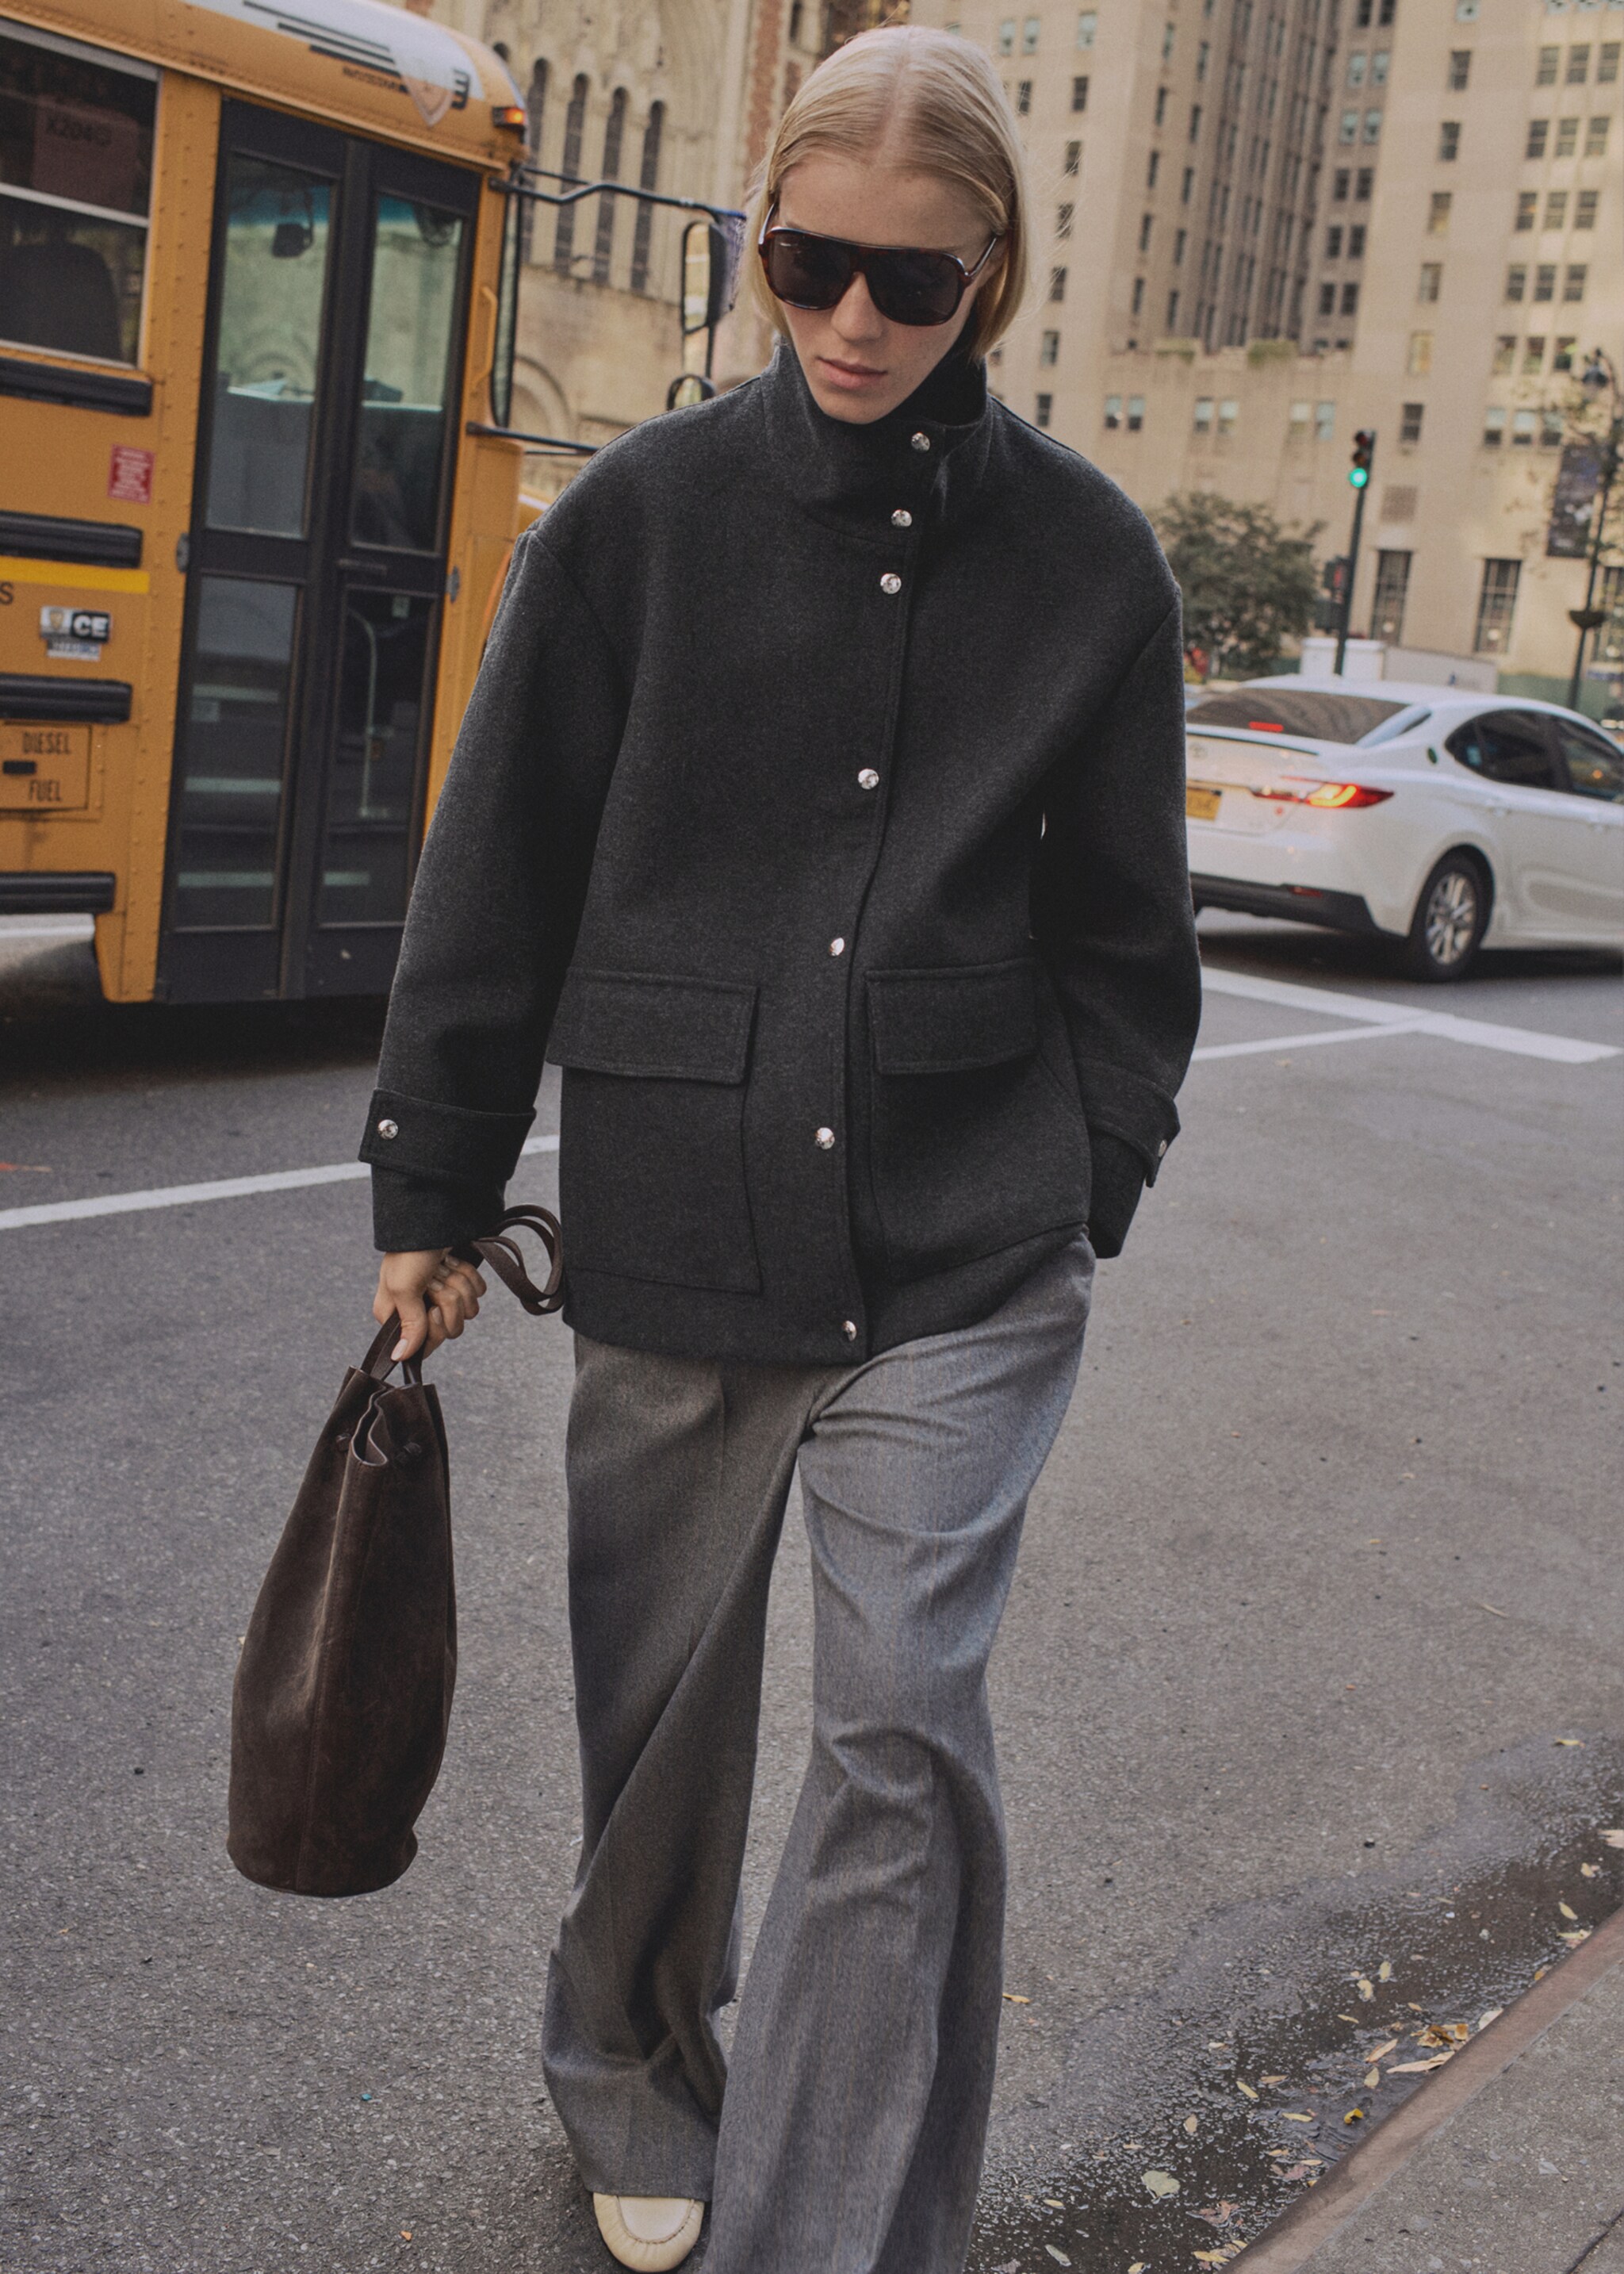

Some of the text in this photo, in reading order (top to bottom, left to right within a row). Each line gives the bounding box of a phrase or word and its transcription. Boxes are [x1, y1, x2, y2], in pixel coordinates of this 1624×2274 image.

[73, 614, 109, 638] CE
[22, 731, 71, 755] DIESEL
[29, 779, 62, 803] FUEL
